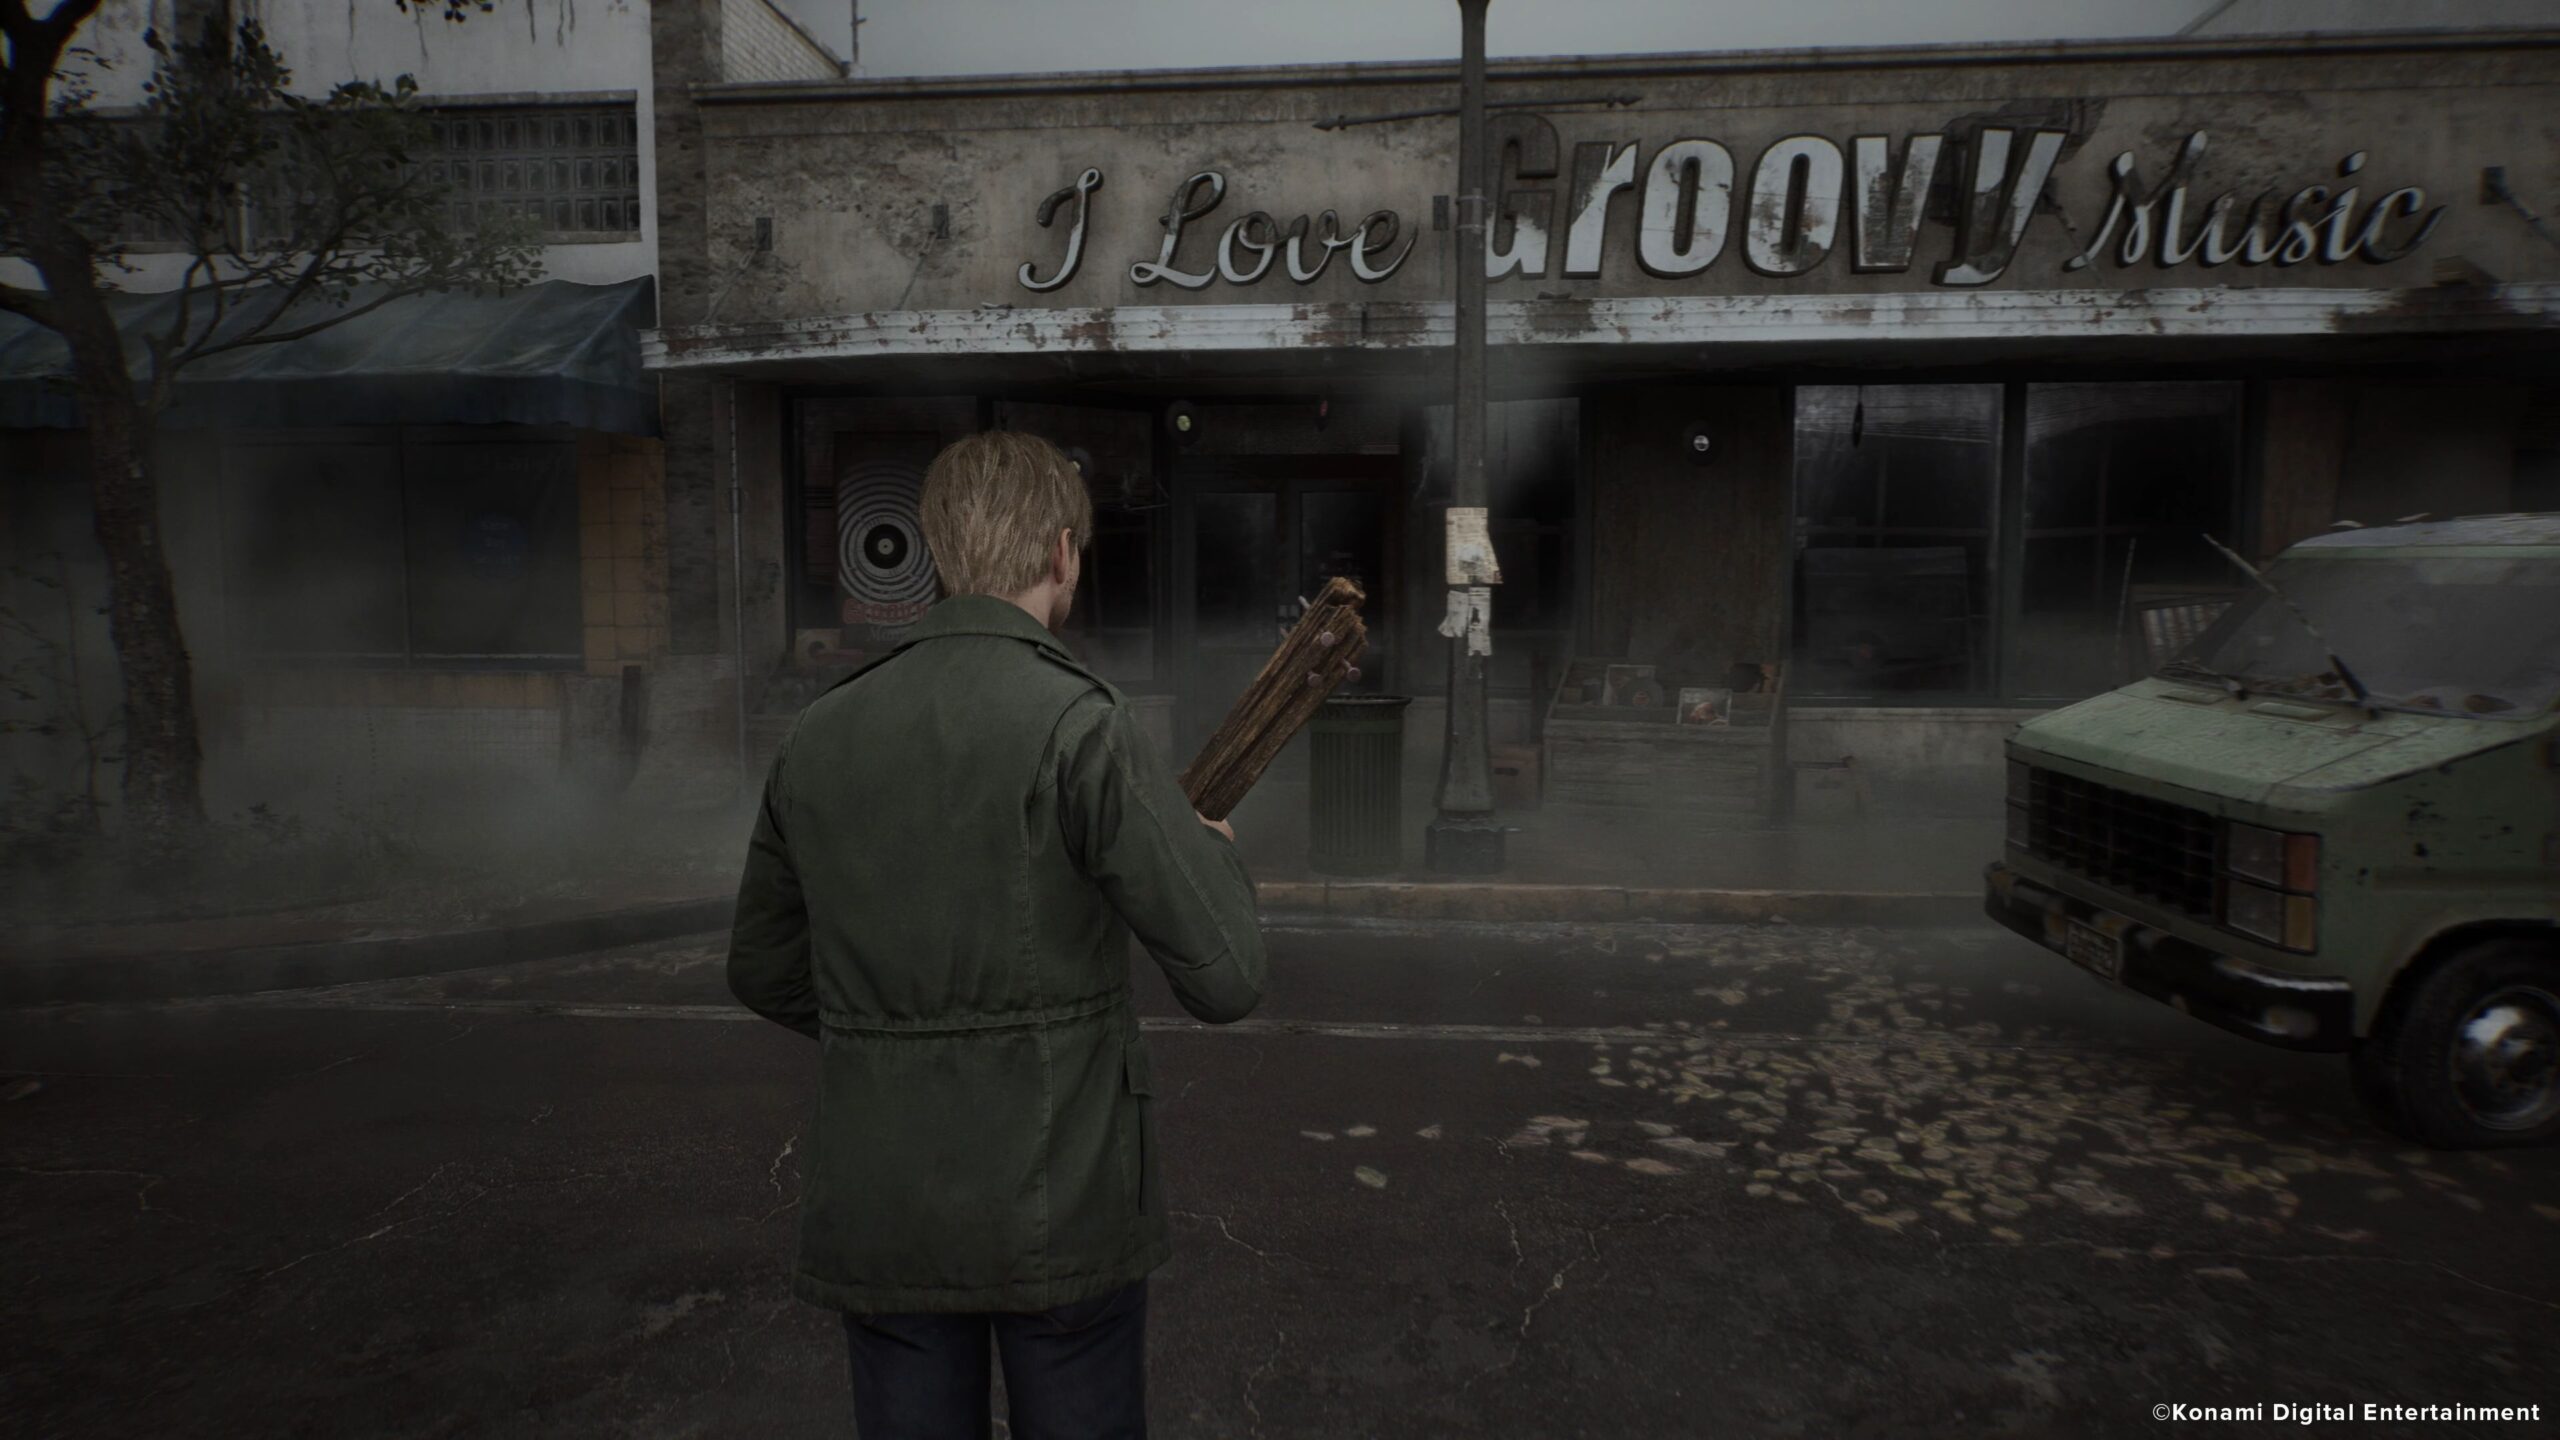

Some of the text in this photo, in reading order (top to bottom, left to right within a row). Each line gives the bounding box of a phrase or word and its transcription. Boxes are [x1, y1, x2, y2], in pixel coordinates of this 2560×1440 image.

[1018, 113, 2447, 292] I Love Groovy Music
